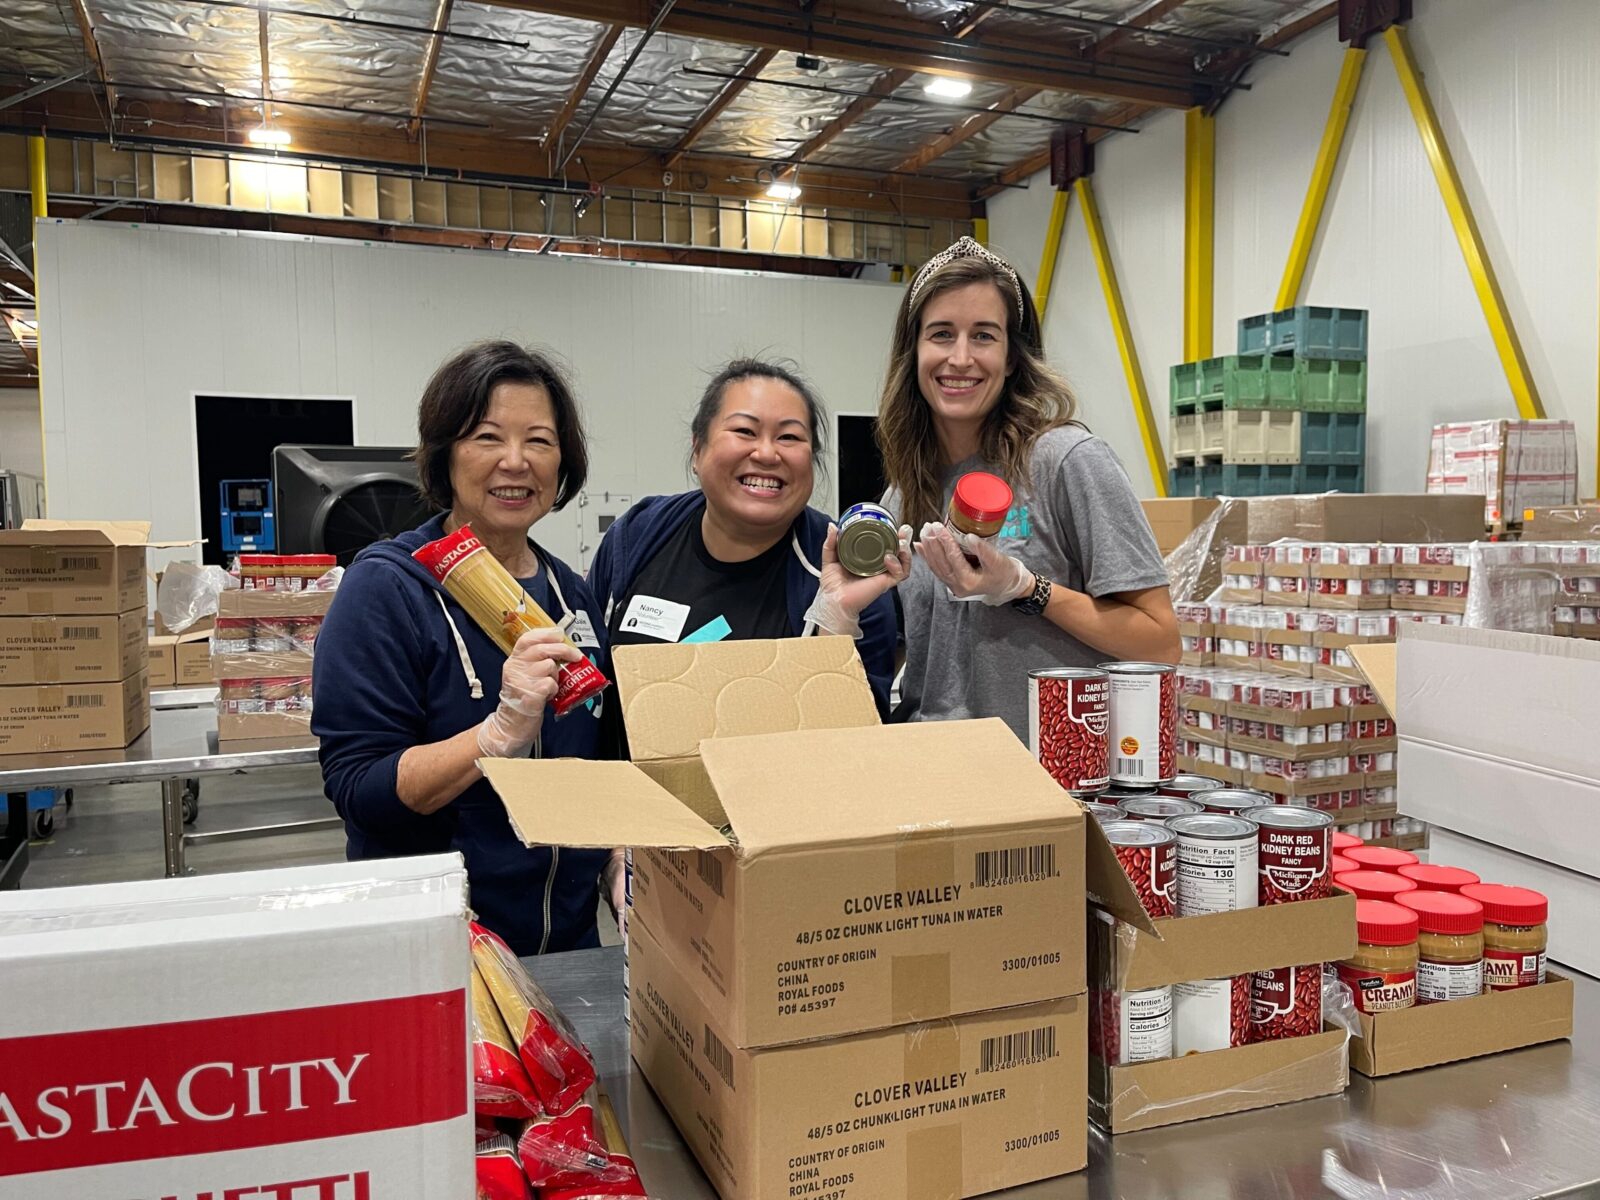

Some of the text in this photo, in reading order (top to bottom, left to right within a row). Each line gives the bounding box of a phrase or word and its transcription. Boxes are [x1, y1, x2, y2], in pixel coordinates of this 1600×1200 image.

[640, 604, 664, 616] Nancy
[1085, 683, 1101, 692] DARK
[1077, 694, 1101, 702] KIDNEY
[1270, 834, 1313, 844] DARK RED
[1177, 843, 1209, 854] Nutrition
[1261, 844, 1292, 856] KIDNEY
[1294, 845, 1321, 856] BEANS
[1177, 866, 1206, 876] Calories
[1272, 871, 1307, 880] Michigan
[970, 881, 974, 889] 8
[985, 877, 1014, 888] 32460
[1018, 873, 1046, 884] 16020
[1279, 878, 1301, 887] Made
[844, 885, 962, 915] CLOVER VALLEY
[797, 905, 1003, 944] 48/5 OZ CHUNK LIGHT TUNA IN WATER
[777, 949, 877, 973] COUNTRY OF ORIGIN
[1002, 952, 1061, 971] 3300/01005
[1483, 962, 1515, 976] AMY
[777, 973, 809, 988] CHINA
[1255, 979, 1285, 991] BEANS
[778, 981, 845, 1002] ROYAL FOODS
[1365, 982, 1414, 1002] CREAMY
[1433, 991, 1446, 999] 180
[778, 998, 836, 1016] PO# 45397
[1130, 998, 1161, 1007] Nutrition
[1371, 1001, 1395, 1010] PEANUT
[647, 981, 695, 1053] CLOVER VALLEY
[1130, 1021, 1160, 1030] Calories
[1020, 1055, 1047, 1066] 16020
[694, 1066, 711, 1096] WATER
[0, 1053, 370, 1141] ASTACITY
[854, 1072, 967, 1109] CLOVER VALLEY
[807, 1088, 1006, 1140] 48/5 OZ CHUNK LIGHT TUNA IN WATER
[1005, 1130, 1060, 1152] 3300/01005
[789, 1139, 885, 1169] COUNTRY OF ORIGIN
[789, 1167, 820, 1183] CHINA
[789, 1173, 854, 1197] ROYAL FOODS
